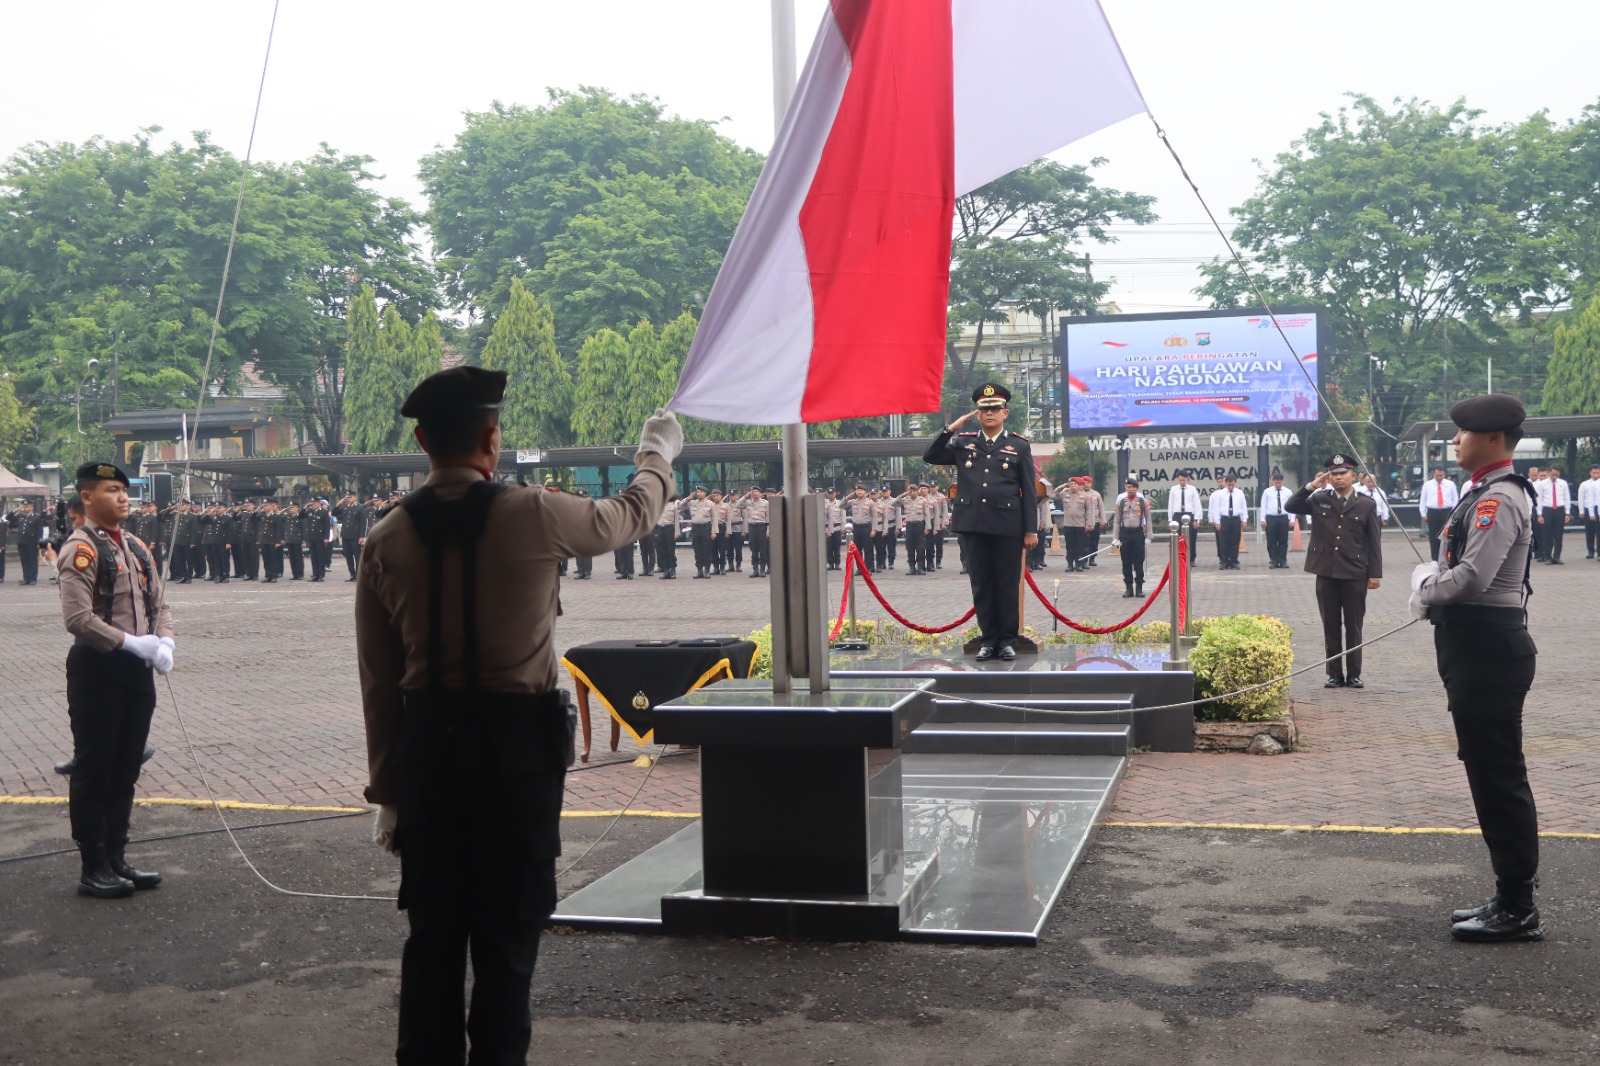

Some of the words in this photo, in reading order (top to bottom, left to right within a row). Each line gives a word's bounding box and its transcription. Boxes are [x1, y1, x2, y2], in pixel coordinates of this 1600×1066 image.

[1182, 352, 1258, 360] PERINGATAN
[1096, 365, 1148, 378] HARI
[1155, 360, 1282, 376] PAHLAWAN
[1135, 373, 1250, 387] NASIONAL
[1088, 436, 1198, 451] WICAKSANA
[1210, 433, 1300, 448] LAGHAWA
[1149, 450, 1215, 462] LAPANGAN
[1218, 449, 1250, 460] APEL
